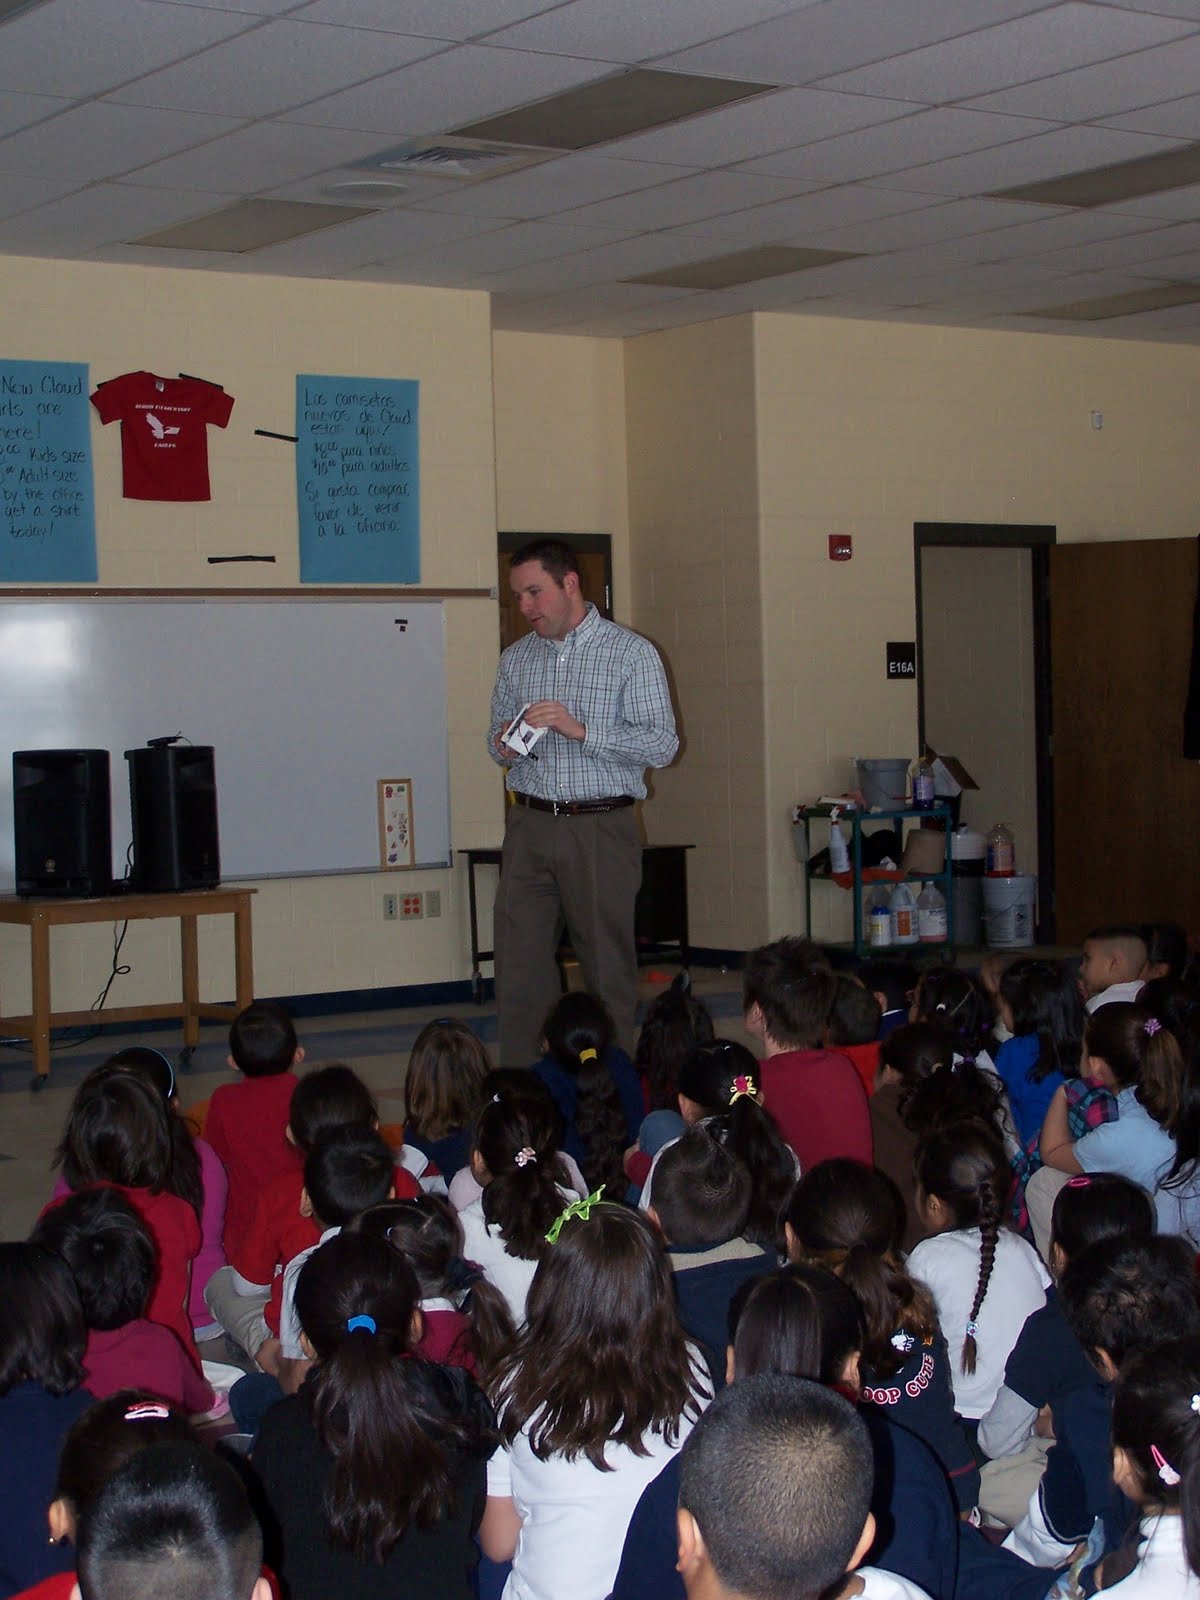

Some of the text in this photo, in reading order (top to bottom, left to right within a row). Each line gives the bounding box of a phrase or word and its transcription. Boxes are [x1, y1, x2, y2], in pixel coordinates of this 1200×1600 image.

[2, 375, 83, 396] New Cloud
[37, 402, 63, 416] are
[30, 446, 57, 463] Kids
[61, 450, 88, 464] size
[19, 466, 50, 484] Adult
[25, 487, 44, 501] the
[5, 502, 27, 524] get
[34, 505, 44, 516] a
[889, 661, 914, 674] E16A
[905, 1352, 935, 1397] CUTE
